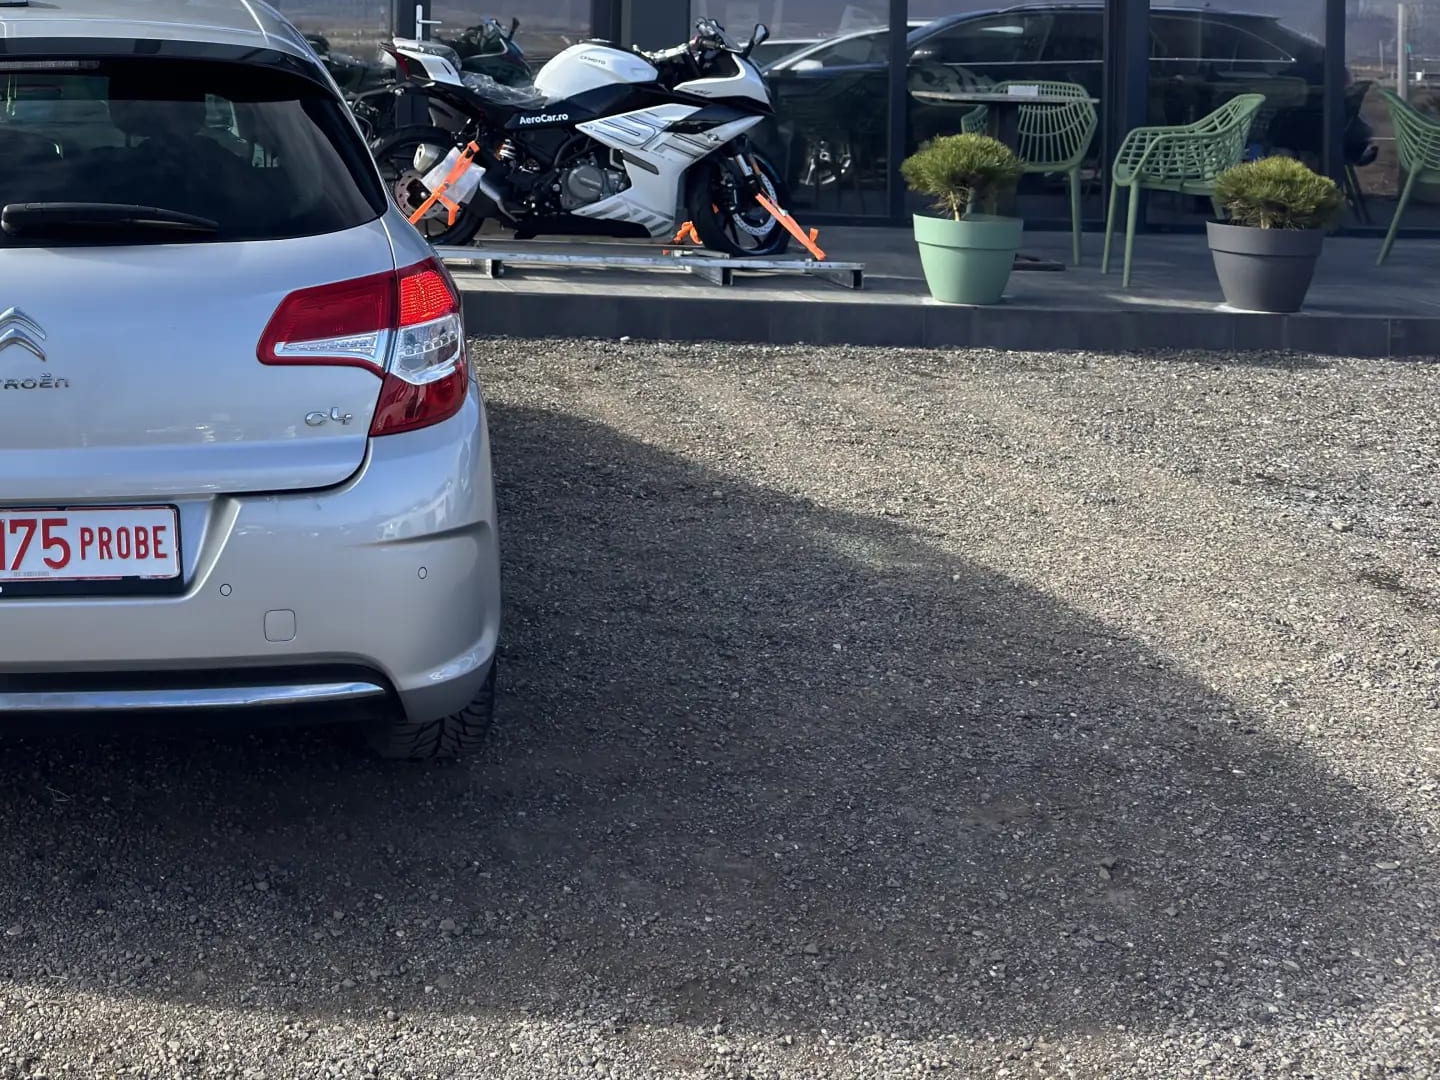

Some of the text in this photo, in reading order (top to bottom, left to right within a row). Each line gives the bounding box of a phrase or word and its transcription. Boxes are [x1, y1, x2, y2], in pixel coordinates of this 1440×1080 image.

[519, 112, 569, 125] AeroCar.ro
[305, 406, 352, 426] C4
[79, 525, 168, 561] PROBE
